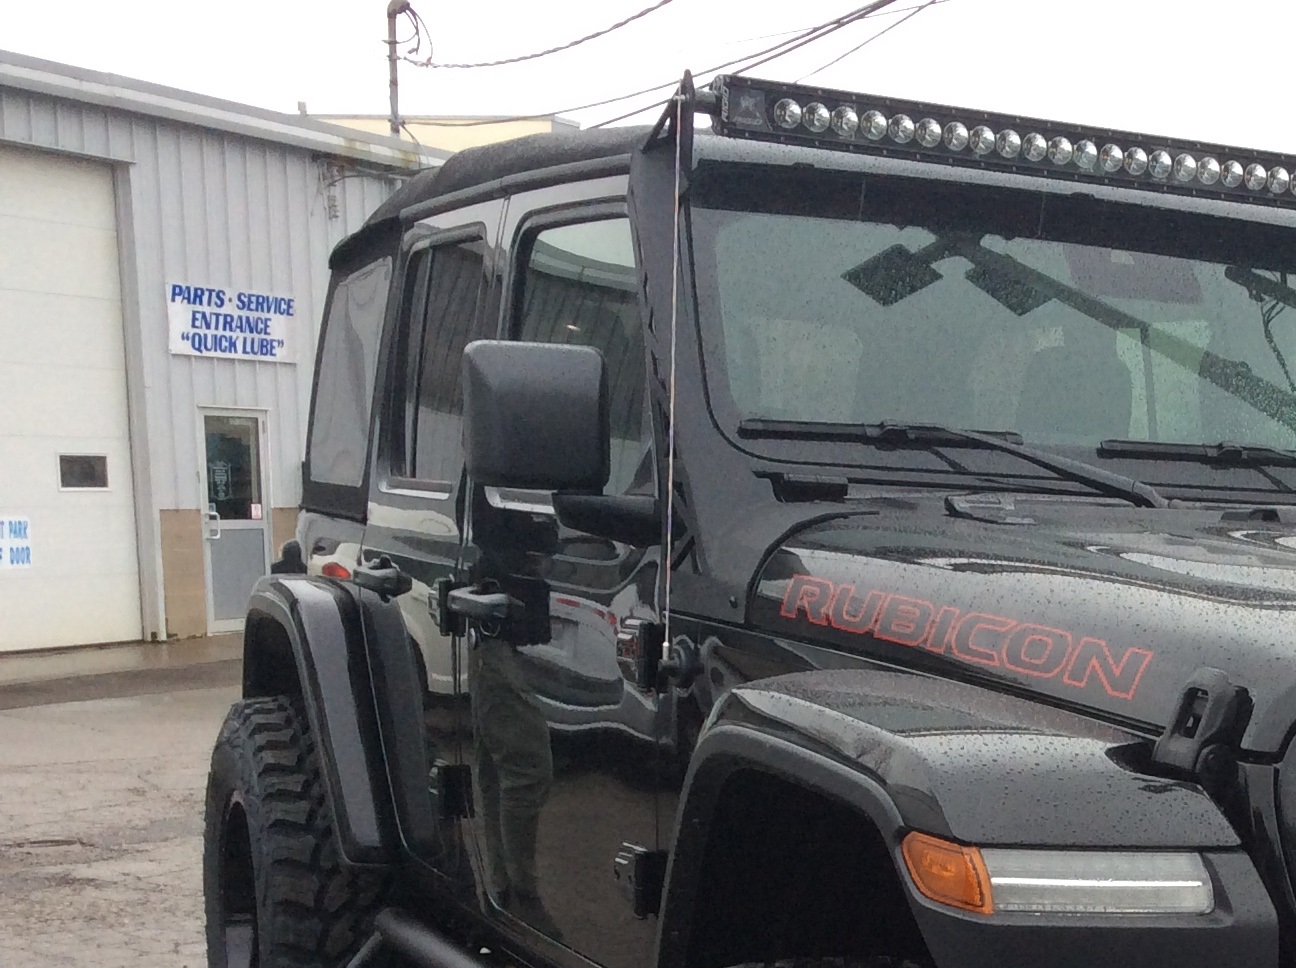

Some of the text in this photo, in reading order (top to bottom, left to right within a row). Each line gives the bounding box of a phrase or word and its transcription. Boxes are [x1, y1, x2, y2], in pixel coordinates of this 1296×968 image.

[170, 284, 295, 316] PARTS SERVICE
[191, 310, 272, 335] ENTRANCE
[9, 520, 28, 539] PARK
[10, 546, 31, 565] DOOR
[779, 573, 1154, 700] RUBICON
